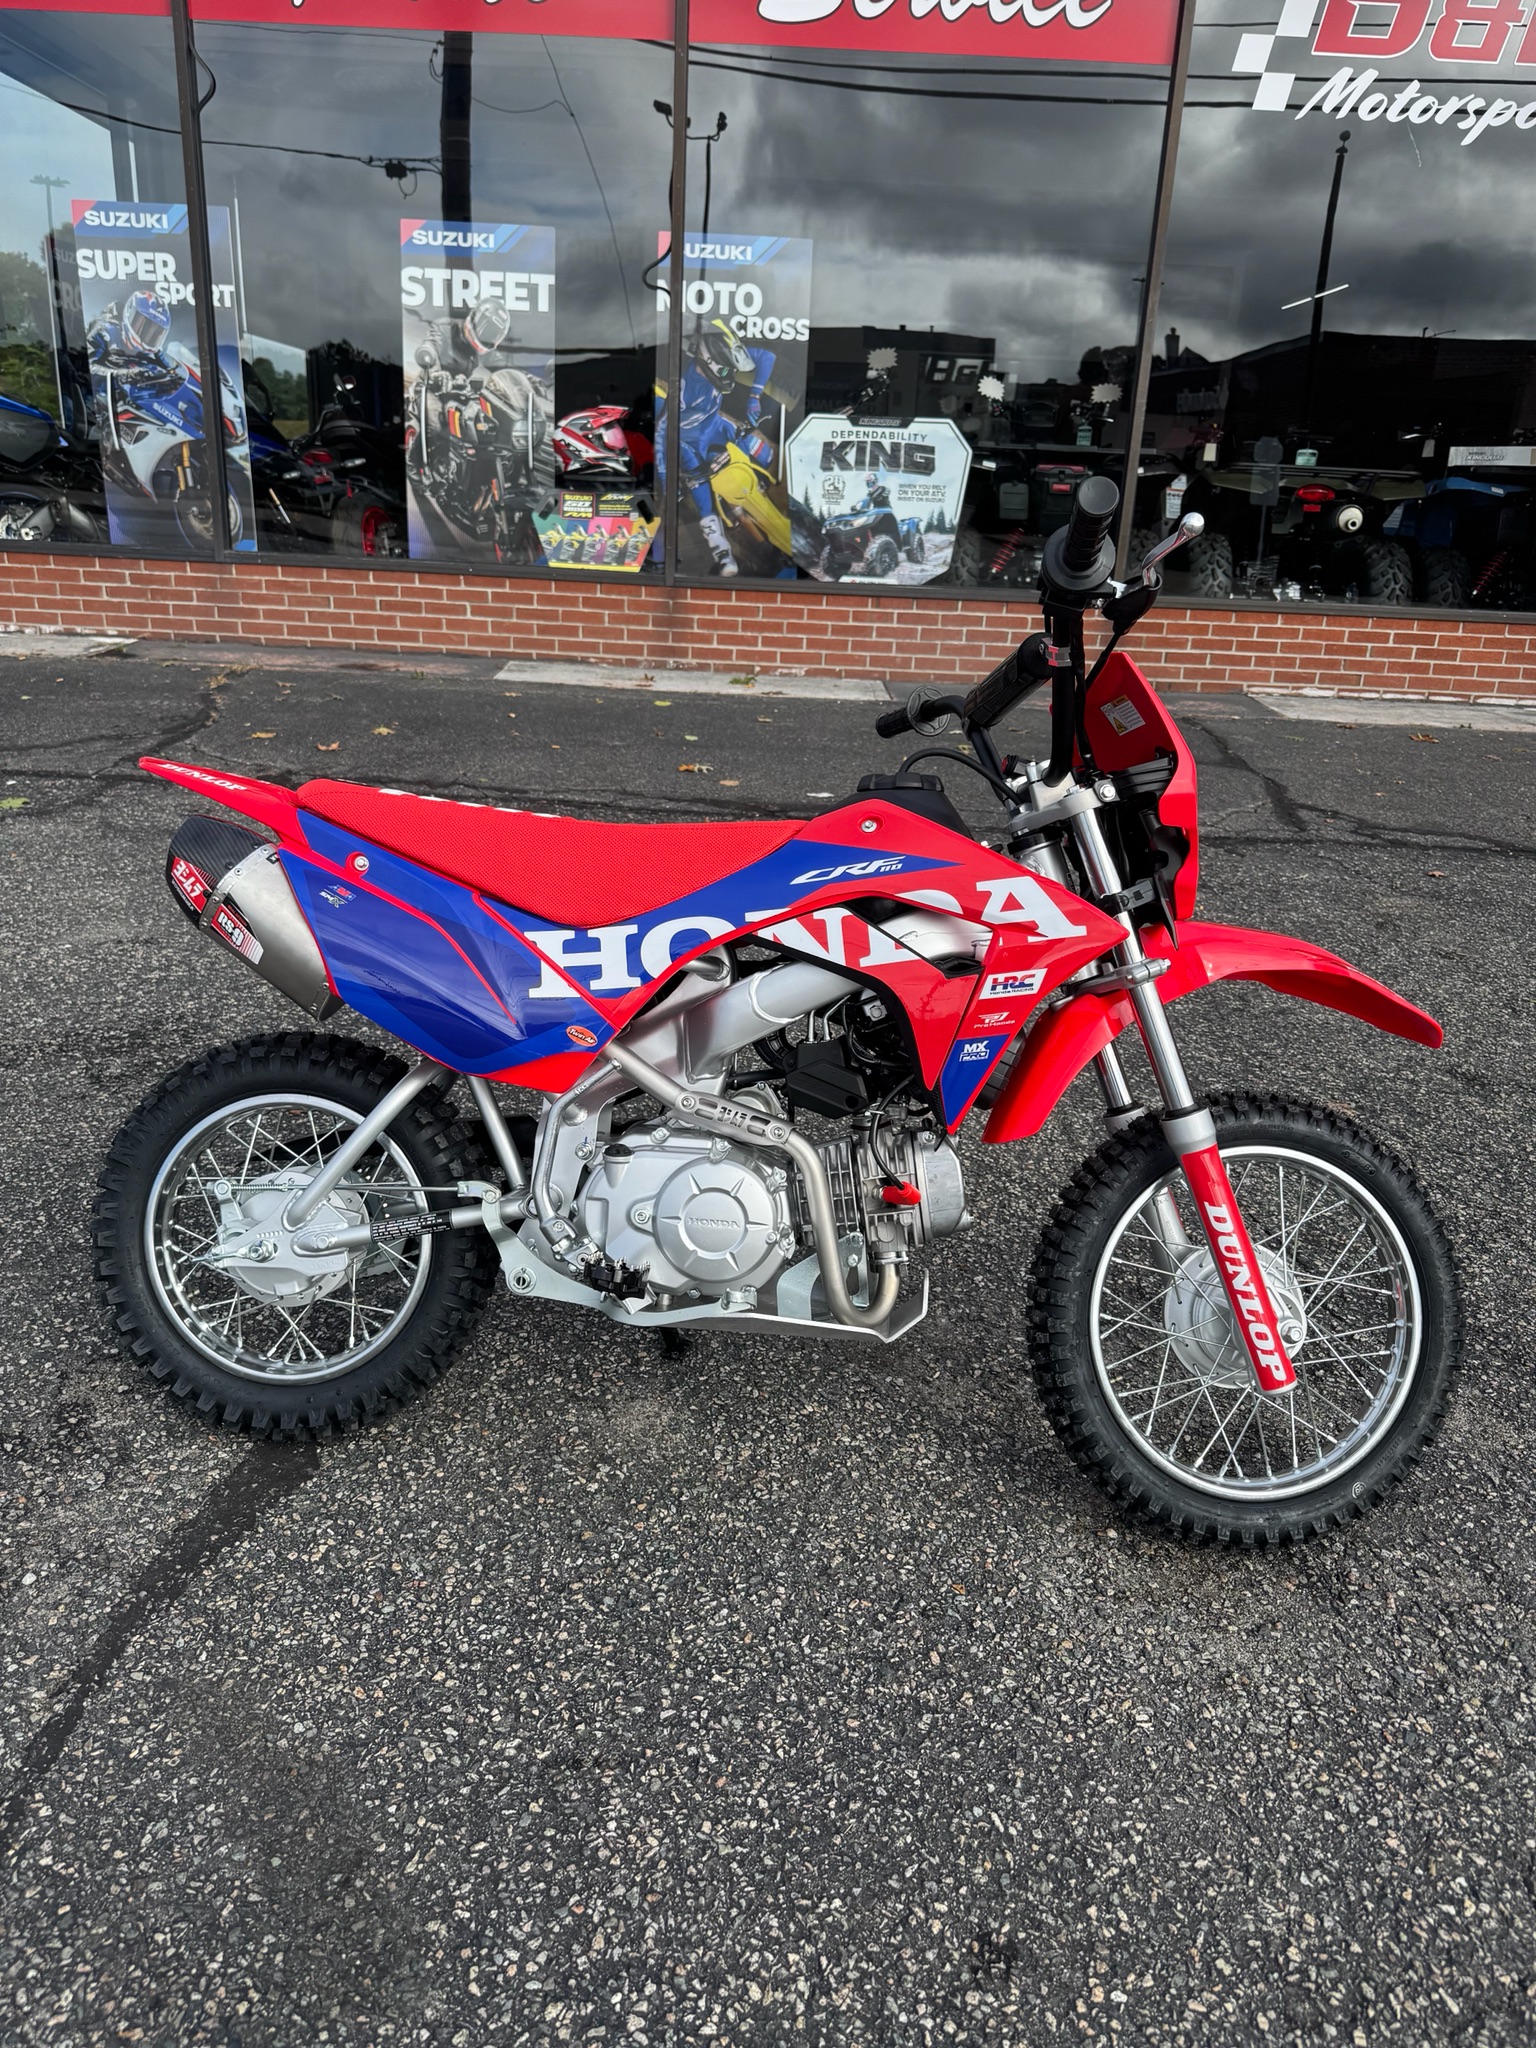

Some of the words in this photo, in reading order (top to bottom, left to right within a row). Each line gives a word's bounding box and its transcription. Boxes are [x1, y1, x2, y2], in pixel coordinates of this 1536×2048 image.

[84, 210, 169, 229] SUZUKI
[412, 229, 495, 248] SUZUKI
[684, 243, 752, 260] UZUKI
[76, 248, 177, 282] SUPER
[401, 266, 555, 312] STREET
[656, 279, 763, 316] MOTO
[729, 315, 810, 341] CROSS
[831, 430, 928, 442] DEPENDABILITY
[820, 440, 936, 477] KING
[159, 763, 248, 791] DUNLOP
[790, 855, 906, 885] CRF
[525, 877, 1087, 999] HONDA
[990, 973, 1036, 991] HRC
[963, 1040, 990, 1053] MX
[687, 1217, 741, 1229] HONDA
[1204, 1201, 1288, 1382] DUNLOP
